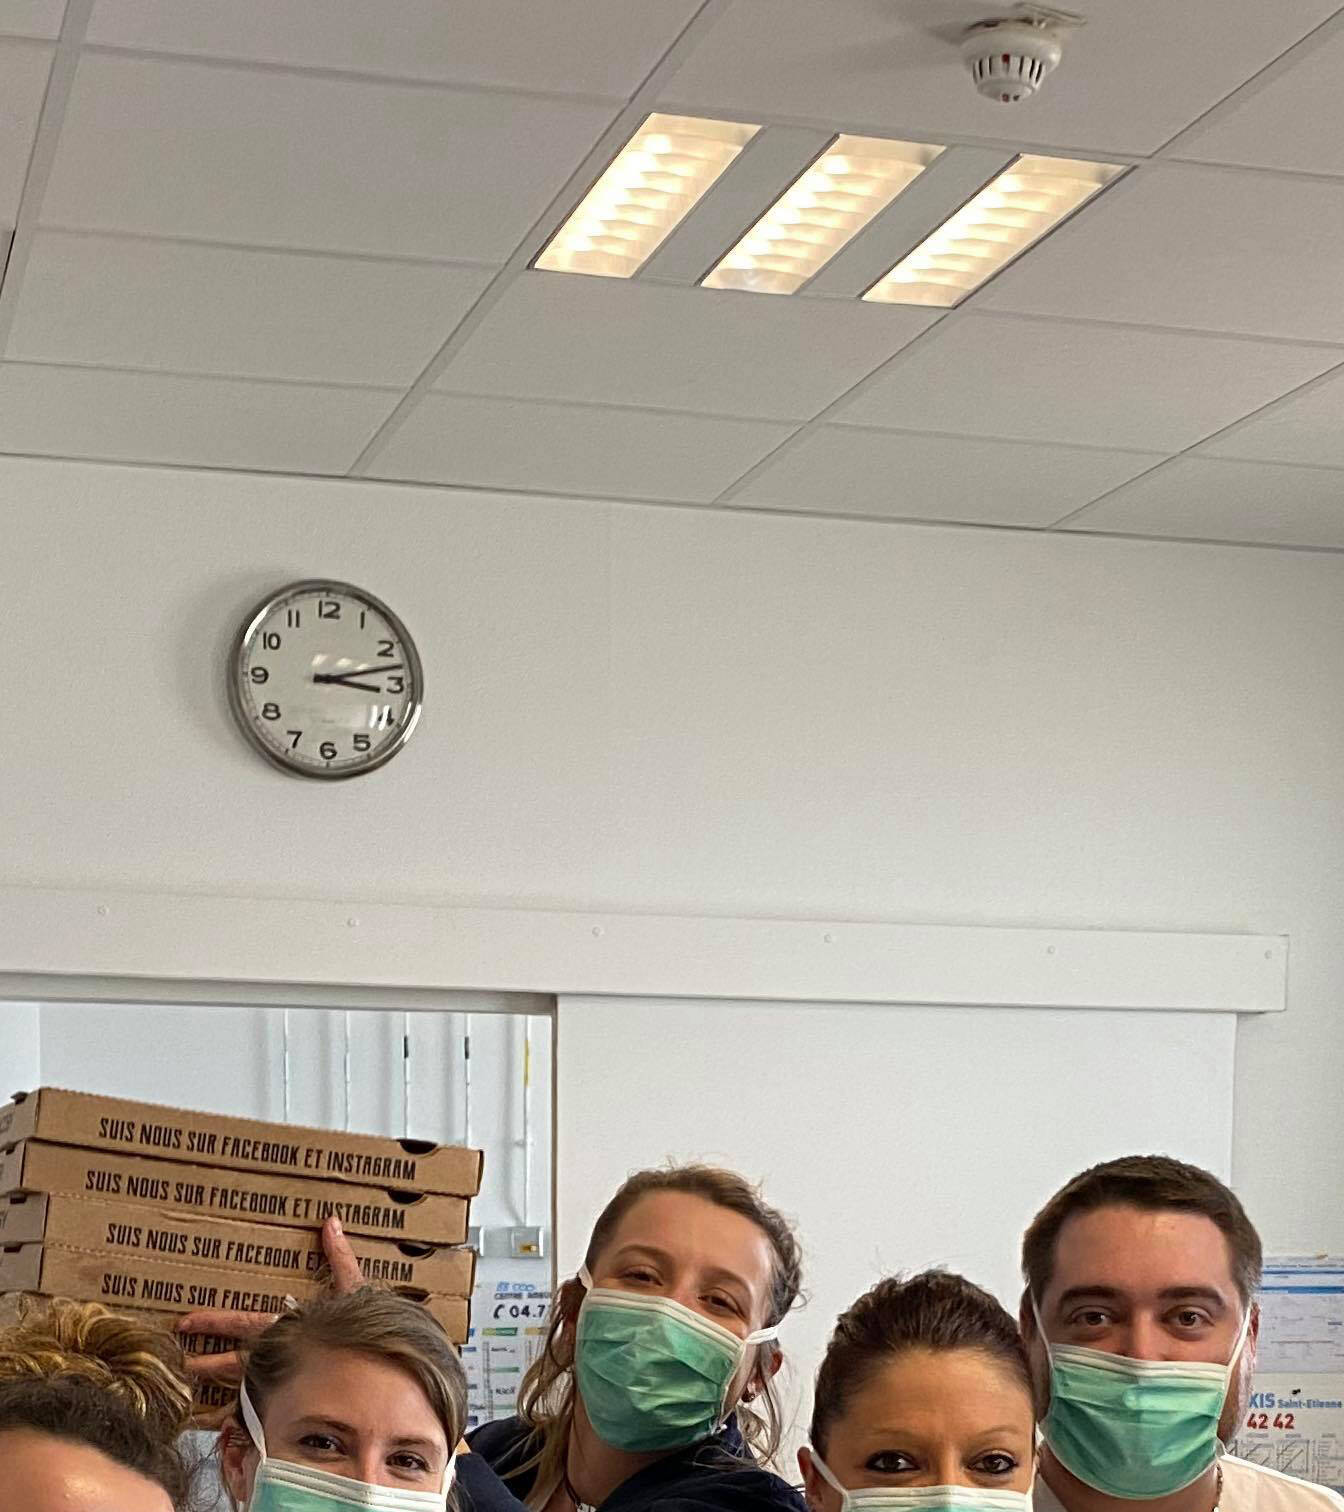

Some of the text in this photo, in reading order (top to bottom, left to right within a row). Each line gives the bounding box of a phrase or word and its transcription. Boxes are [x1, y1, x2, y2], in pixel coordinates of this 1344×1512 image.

[287, 609, 300, 628] 11
[318, 600, 341, 620] 12
[360, 611, 366, 630] 1
[263, 632, 281, 650] 10
[377, 640, 394, 657] 2
[251, 666, 269, 684] 9
[387, 676, 404, 694] 3
[262, 703, 281, 720] 8
[287, 731, 303, 749] 7
[353, 734, 371, 751] 5
[319, 742, 337, 760] 6
[99, 1117, 416, 1180] SUIS NOUS SUR FACEBOOK ET INSTAGRAM
[85, 1170, 405, 1229] SUIS NOUS SUR FACEBOOK ET INSTAGRAM
[106, 1223, 141, 1247] SUIS
[146, 1228, 188, 1255] NOUS
[193, 1235, 221, 1259] SUR
[226, 1240, 300, 1270] FACEBOOK
[357, 1255, 414, 1283] TAGRAM
[102, 1273, 288, 1313] SUIS NOUS SUR FACEBO
[1247, 1413, 1295, 1430] 42 42
